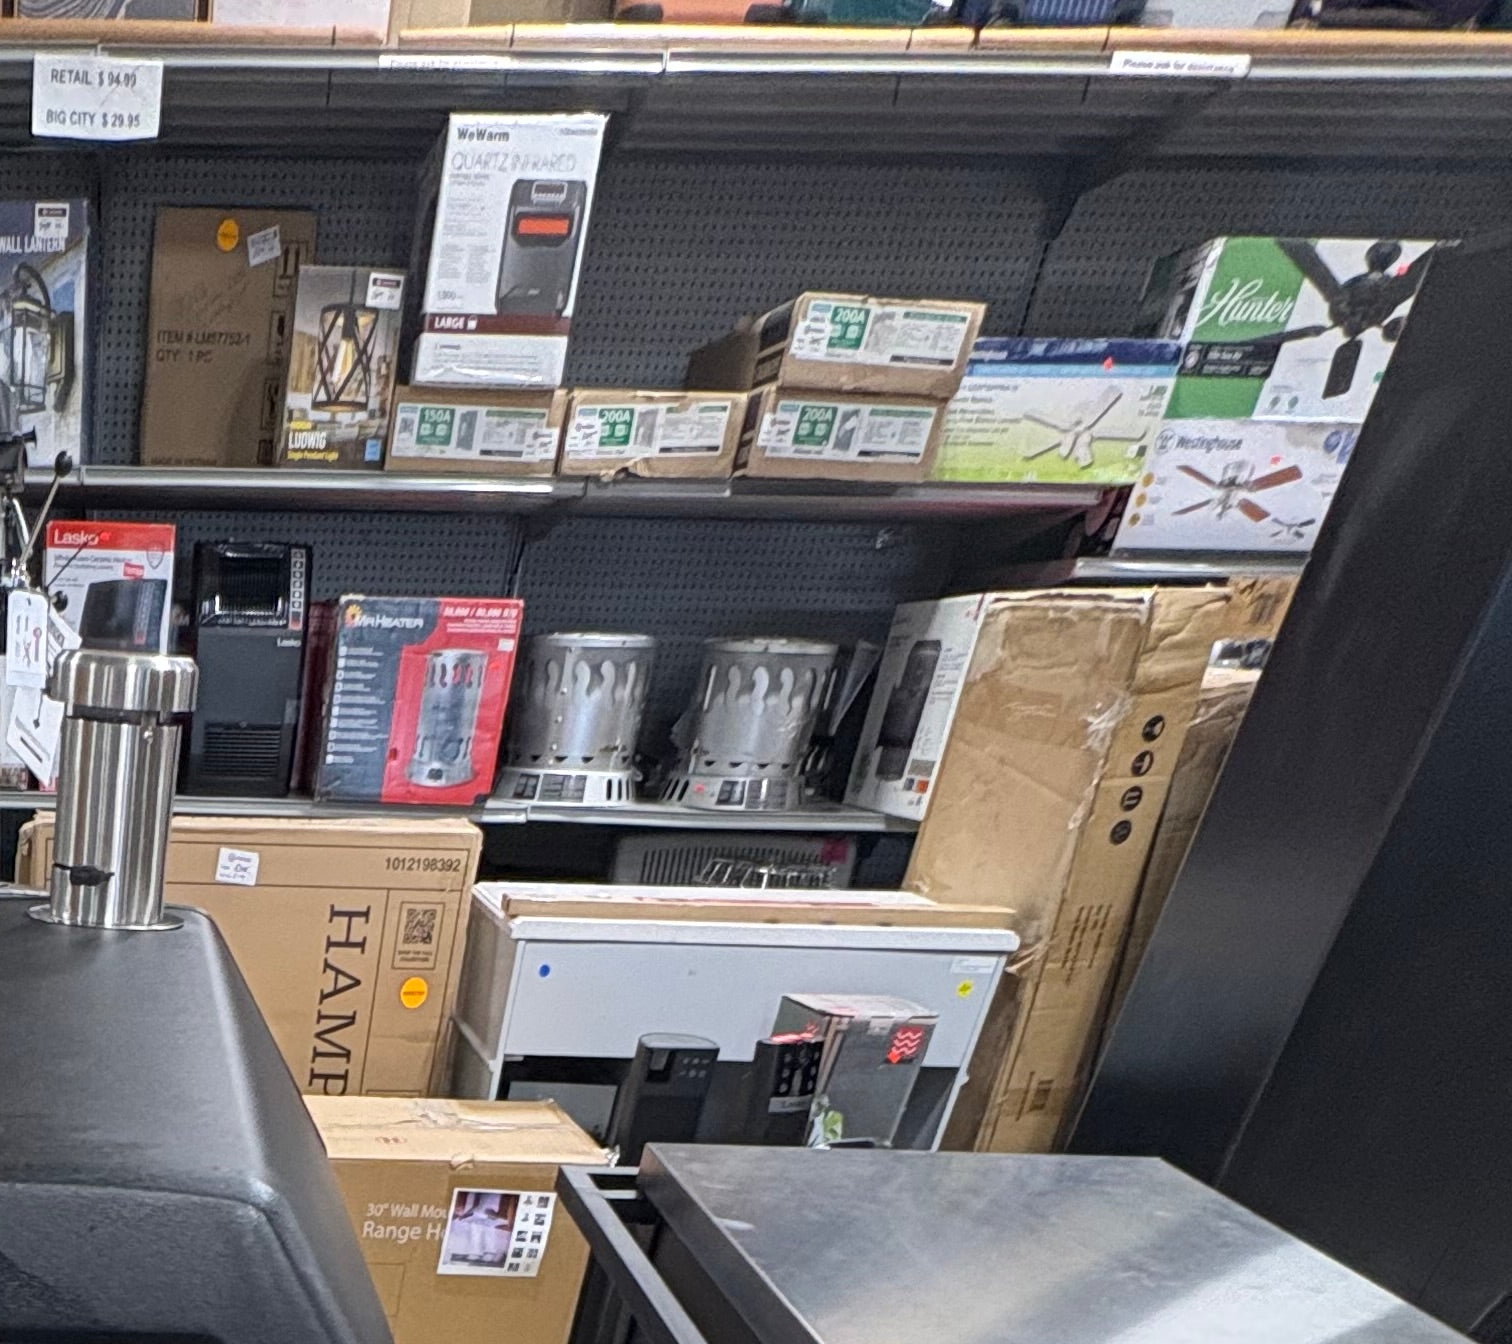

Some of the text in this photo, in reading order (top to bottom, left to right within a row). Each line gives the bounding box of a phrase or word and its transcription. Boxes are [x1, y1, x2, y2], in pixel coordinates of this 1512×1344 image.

[50, 68, 92, 86] RETAIL
[97, 70, 105, 88] $
[45, 108, 67, 125] BIG
[69, 110, 96, 127] CITY
[101, 112, 109, 129] $
[457, 127, 510, 142] WeWarm
[450, 151, 508, 172] QUARTZ
[24, 235, 66, 254] LANTERN
[1195, 277, 1296, 328] Hunter
[433, 316, 466, 330] LARGE
[834, 307, 866, 324] 200A
[155, 350, 180, 363] QTY
[423, 408, 451, 423] 150A
[600, 408, 631, 424] 200A
[801, 406, 833, 422] 200A
[287, 430, 327, 450] LUDWIG
[1175, 434, 1243, 454] Westinghouse
[53, 528, 99, 546] Lasko
[384, 856, 461, 873] 1012198392
[308, 903, 371, 1096] HAMP
[391, 1203, 419, 1219] Wall
[362, 1221, 421, 1245] Range
